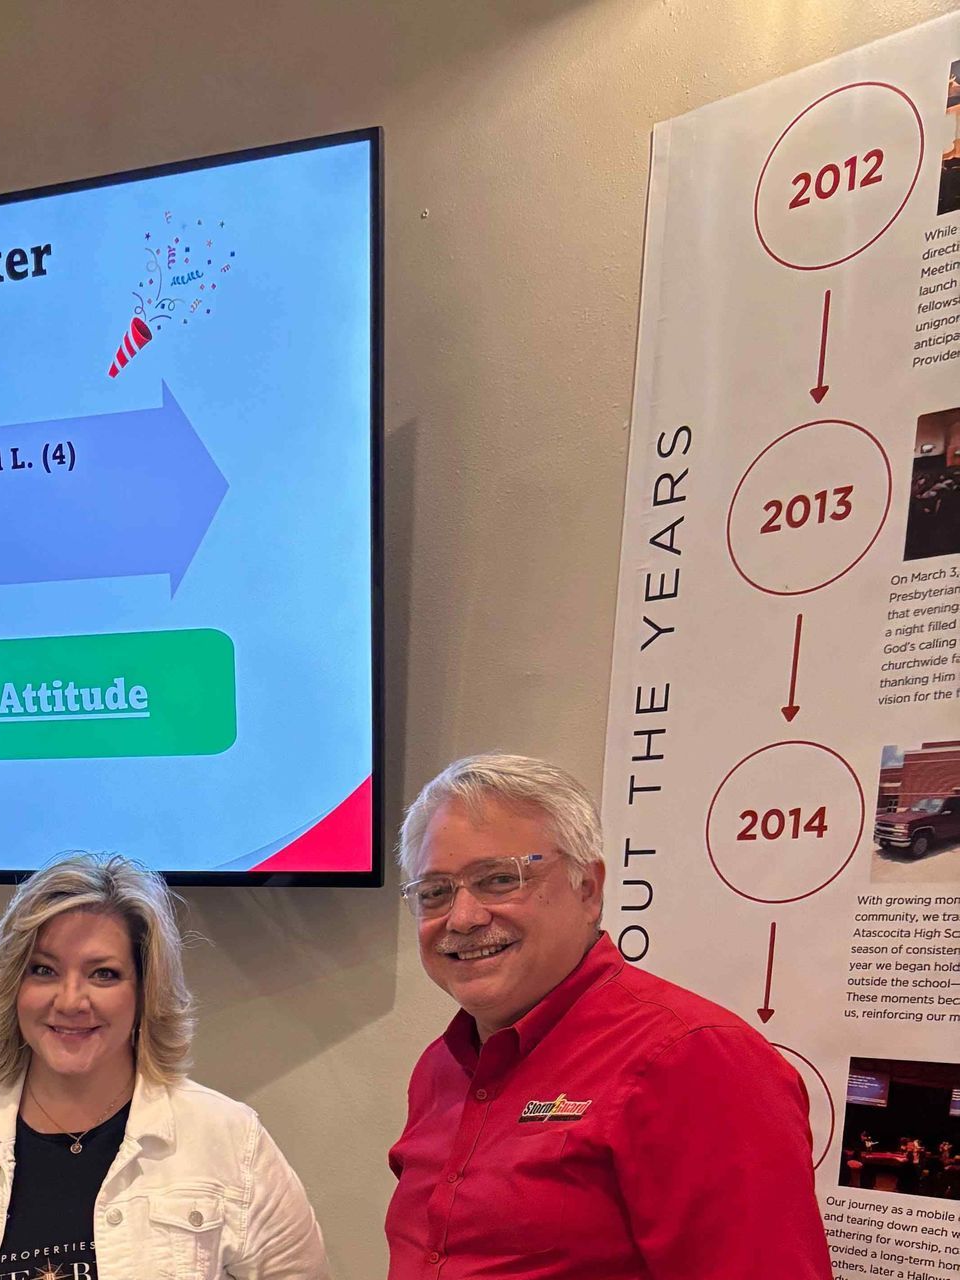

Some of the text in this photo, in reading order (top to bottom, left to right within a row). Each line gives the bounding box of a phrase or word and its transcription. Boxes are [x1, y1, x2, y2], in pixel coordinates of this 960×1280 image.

[789, 149, 884, 210] 2012
[925, 225, 958, 242] While
[921, 243, 960, 261] directi
[921, 261, 960, 279] Meetin
[919, 278, 957, 296] launch
[917, 295, 960, 314] fellows
[915, 315, 960, 332] unignor
[914, 332, 960, 350] anticipa
[912, 349, 960, 368] Provide
[10, 447, 33, 469] L.
[42, 441, 76, 474] (4)
[760, 485, 854, 534] 2013
[890, 575, 908, 586] On
[911, 568, 946, 583] March
[889, 585, 960, 603] Presbyterian
[887, 603, 960, 621] that evening
[885, 619, 957, 638] a night filled
[883, 638, 957, 654] God's calling
[881, 653, 960, 672] churchwide fa
[880, 672, 955, 689] thanking Him
[618, 425, 692, 963] OUT THE YEARS
[878, 690, 953, 705] vision for the
[736, 806, 828, 841] 2014
[857, 895, 960, 907] With growing mo
[855, 912, 960, 923] community, we tra
[853, 928, 960, 940] Atascocita High Sc
[851, 944, 960, 955] season of consiste
[849, 961, 960, 973] year we began hold
[847, 976, 960, 989] outside the school—
[846, 992, 960, 1006] These moments bec
[844, 1009, 947, 1022] us, reinforcing our
[826, 1196, 955, 1222] Our journey as a mobile
[824, 1213, 948, 1237] and tearing down each
[1, 1241, 96, 1263] PROPERTIES
[876, 1234, 891, 1244] for
[894, 1239, 941, 1254] worship,
[870, 1264, 895, 1277] later
[897, 1271, 904, 1279] a
